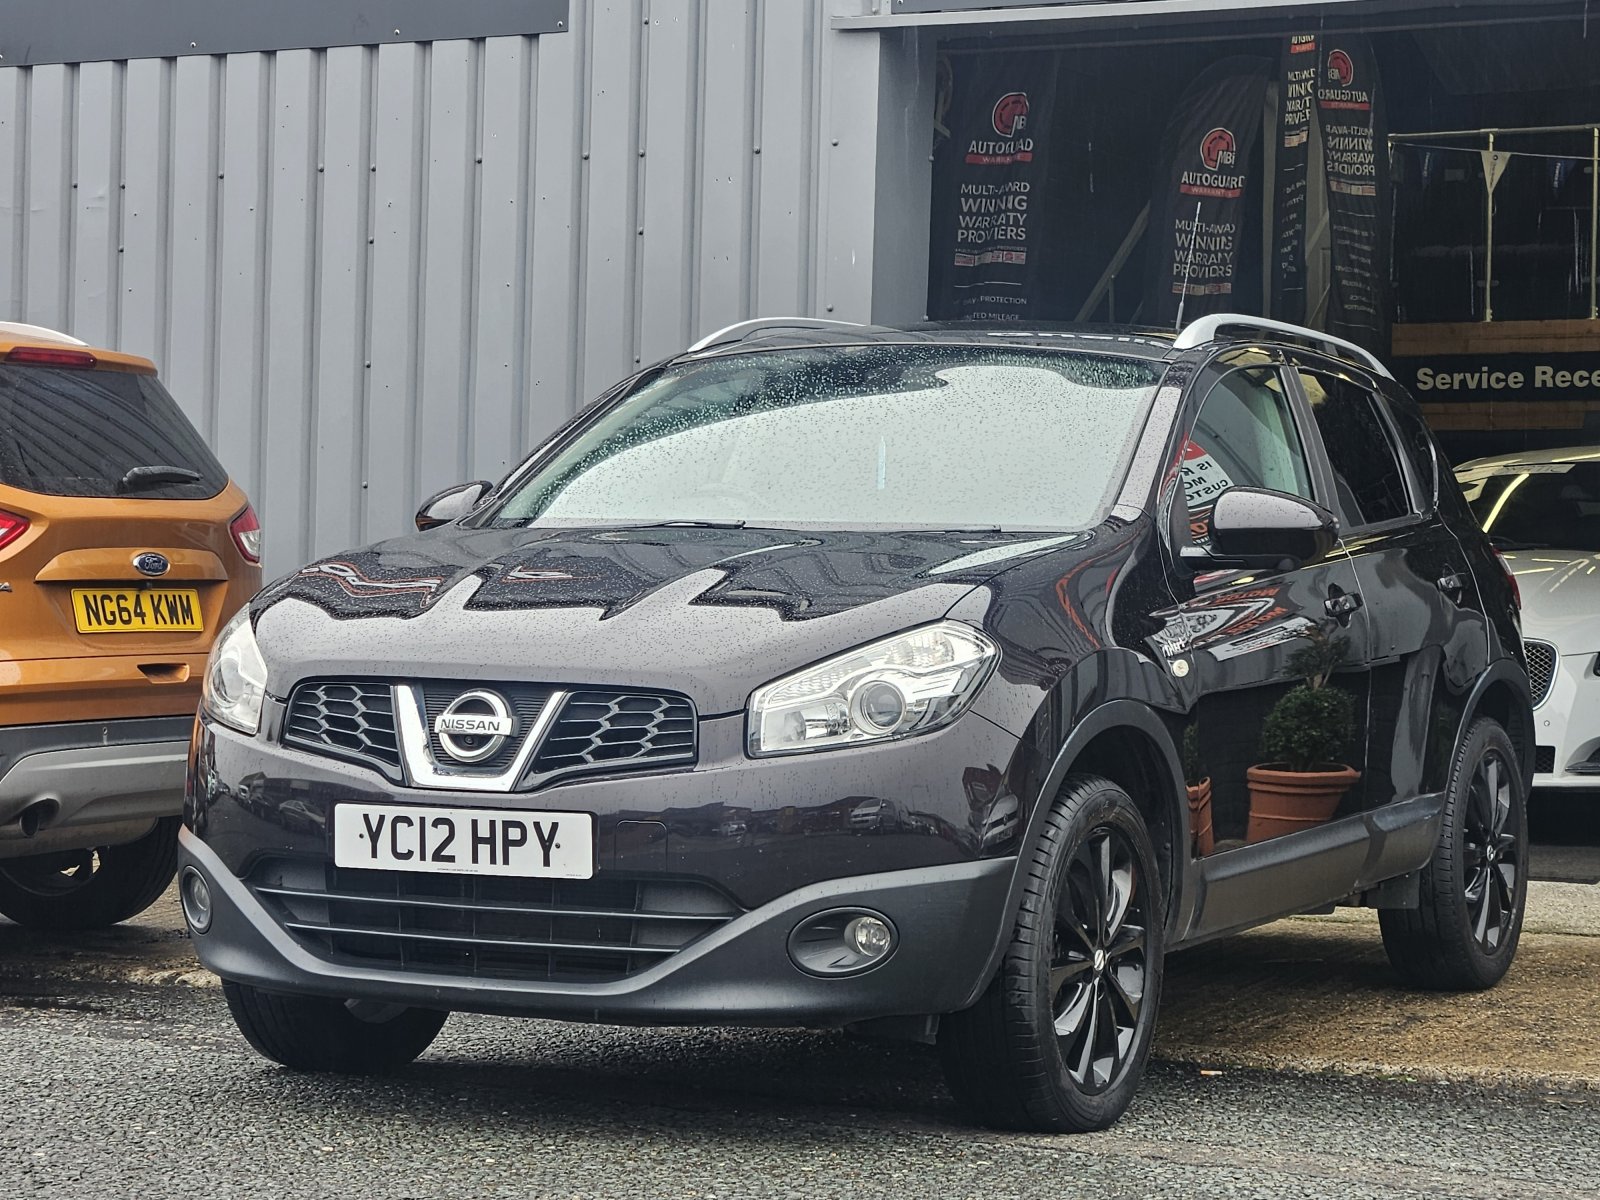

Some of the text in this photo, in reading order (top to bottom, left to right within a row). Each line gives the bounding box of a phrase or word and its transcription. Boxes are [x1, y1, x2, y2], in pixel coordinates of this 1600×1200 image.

[980, 295, 1027, 305] PROTECTION
[1416, 366, 1525, 391] Service
[144, 556, 164, 570] Ford
[82, 593, 195, 626] NG64 KWM
[440, 717, 501, 732] NISSAN
[362, 812, 560, 868] YC12 HPY
